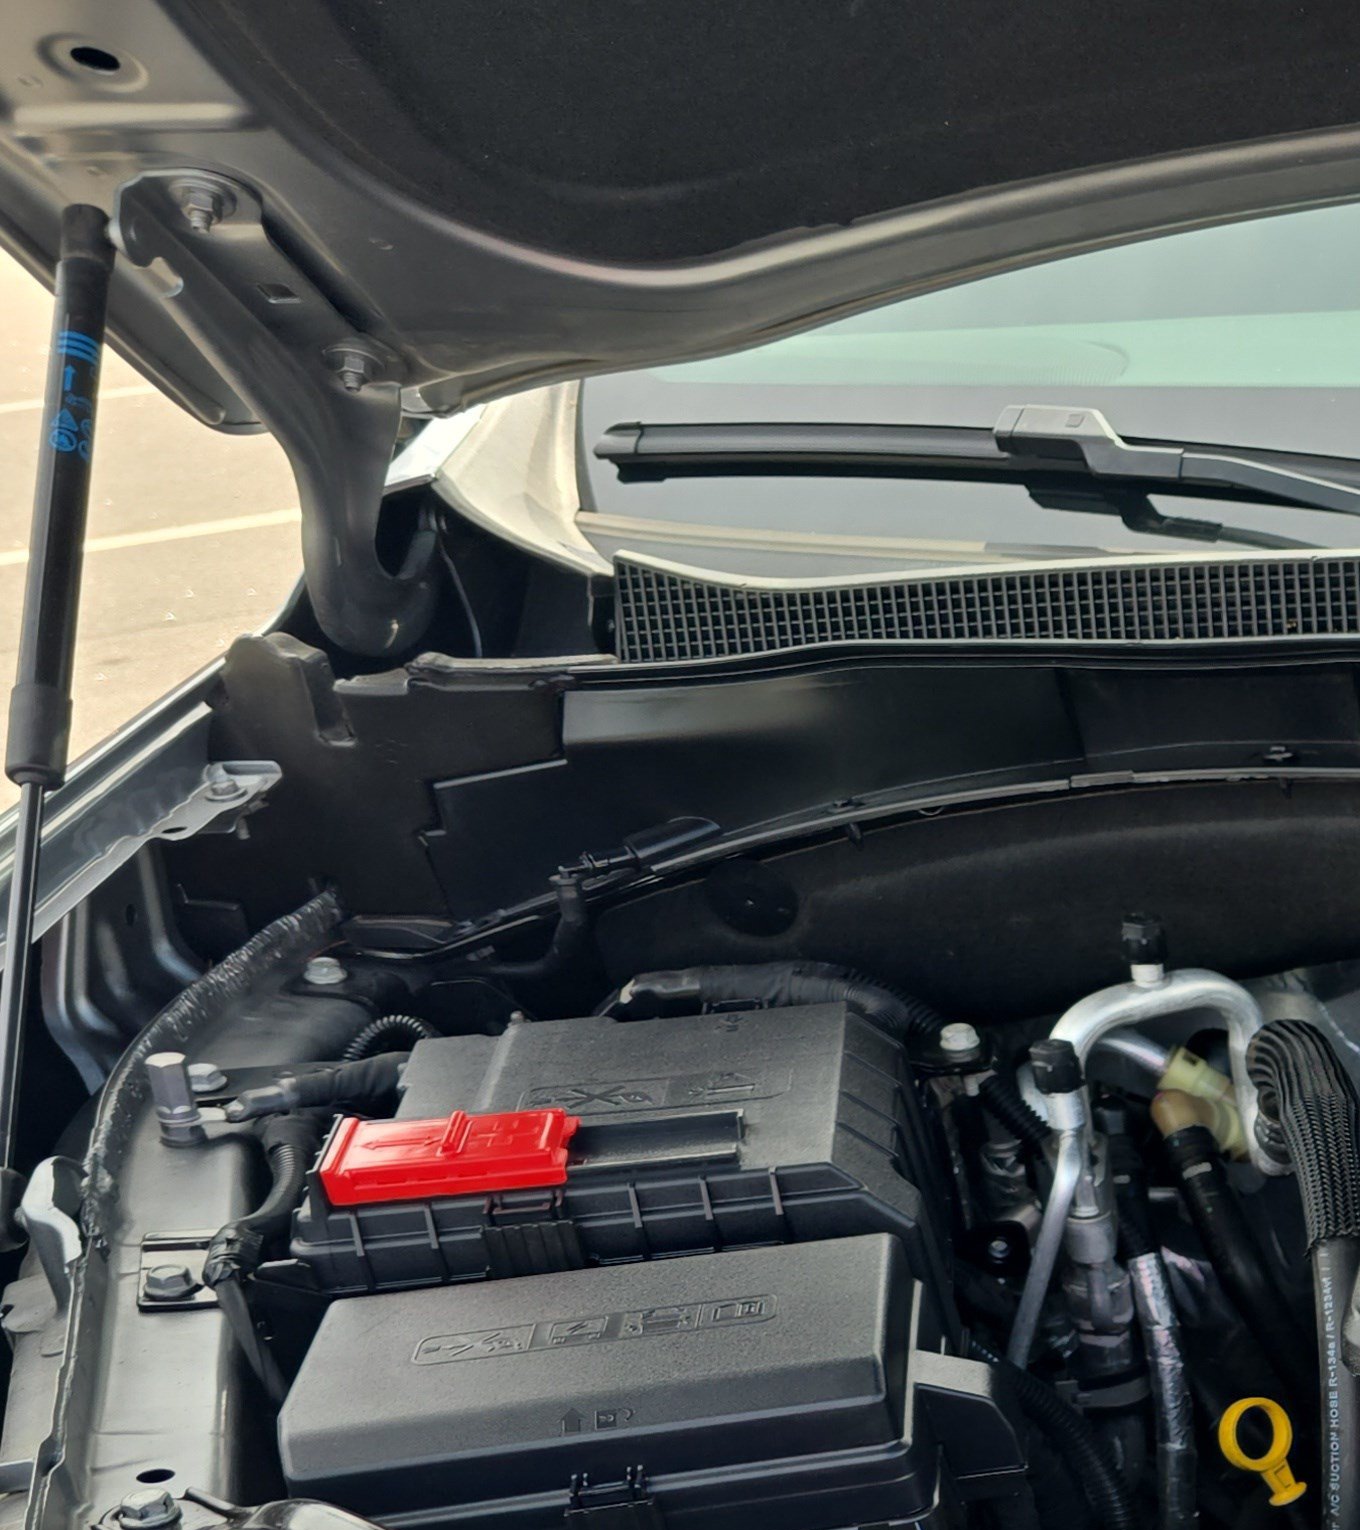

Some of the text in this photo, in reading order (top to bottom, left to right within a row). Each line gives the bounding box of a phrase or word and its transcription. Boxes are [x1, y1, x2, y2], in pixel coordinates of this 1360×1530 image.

[1325, 1342, 1339, 1387] R-134a
[1328, 1390, 1340, 1429] HOSE
[1329, 1431, 1341, 1491] SUCTION
[1329, 1494, 1341, 1517] A/C
